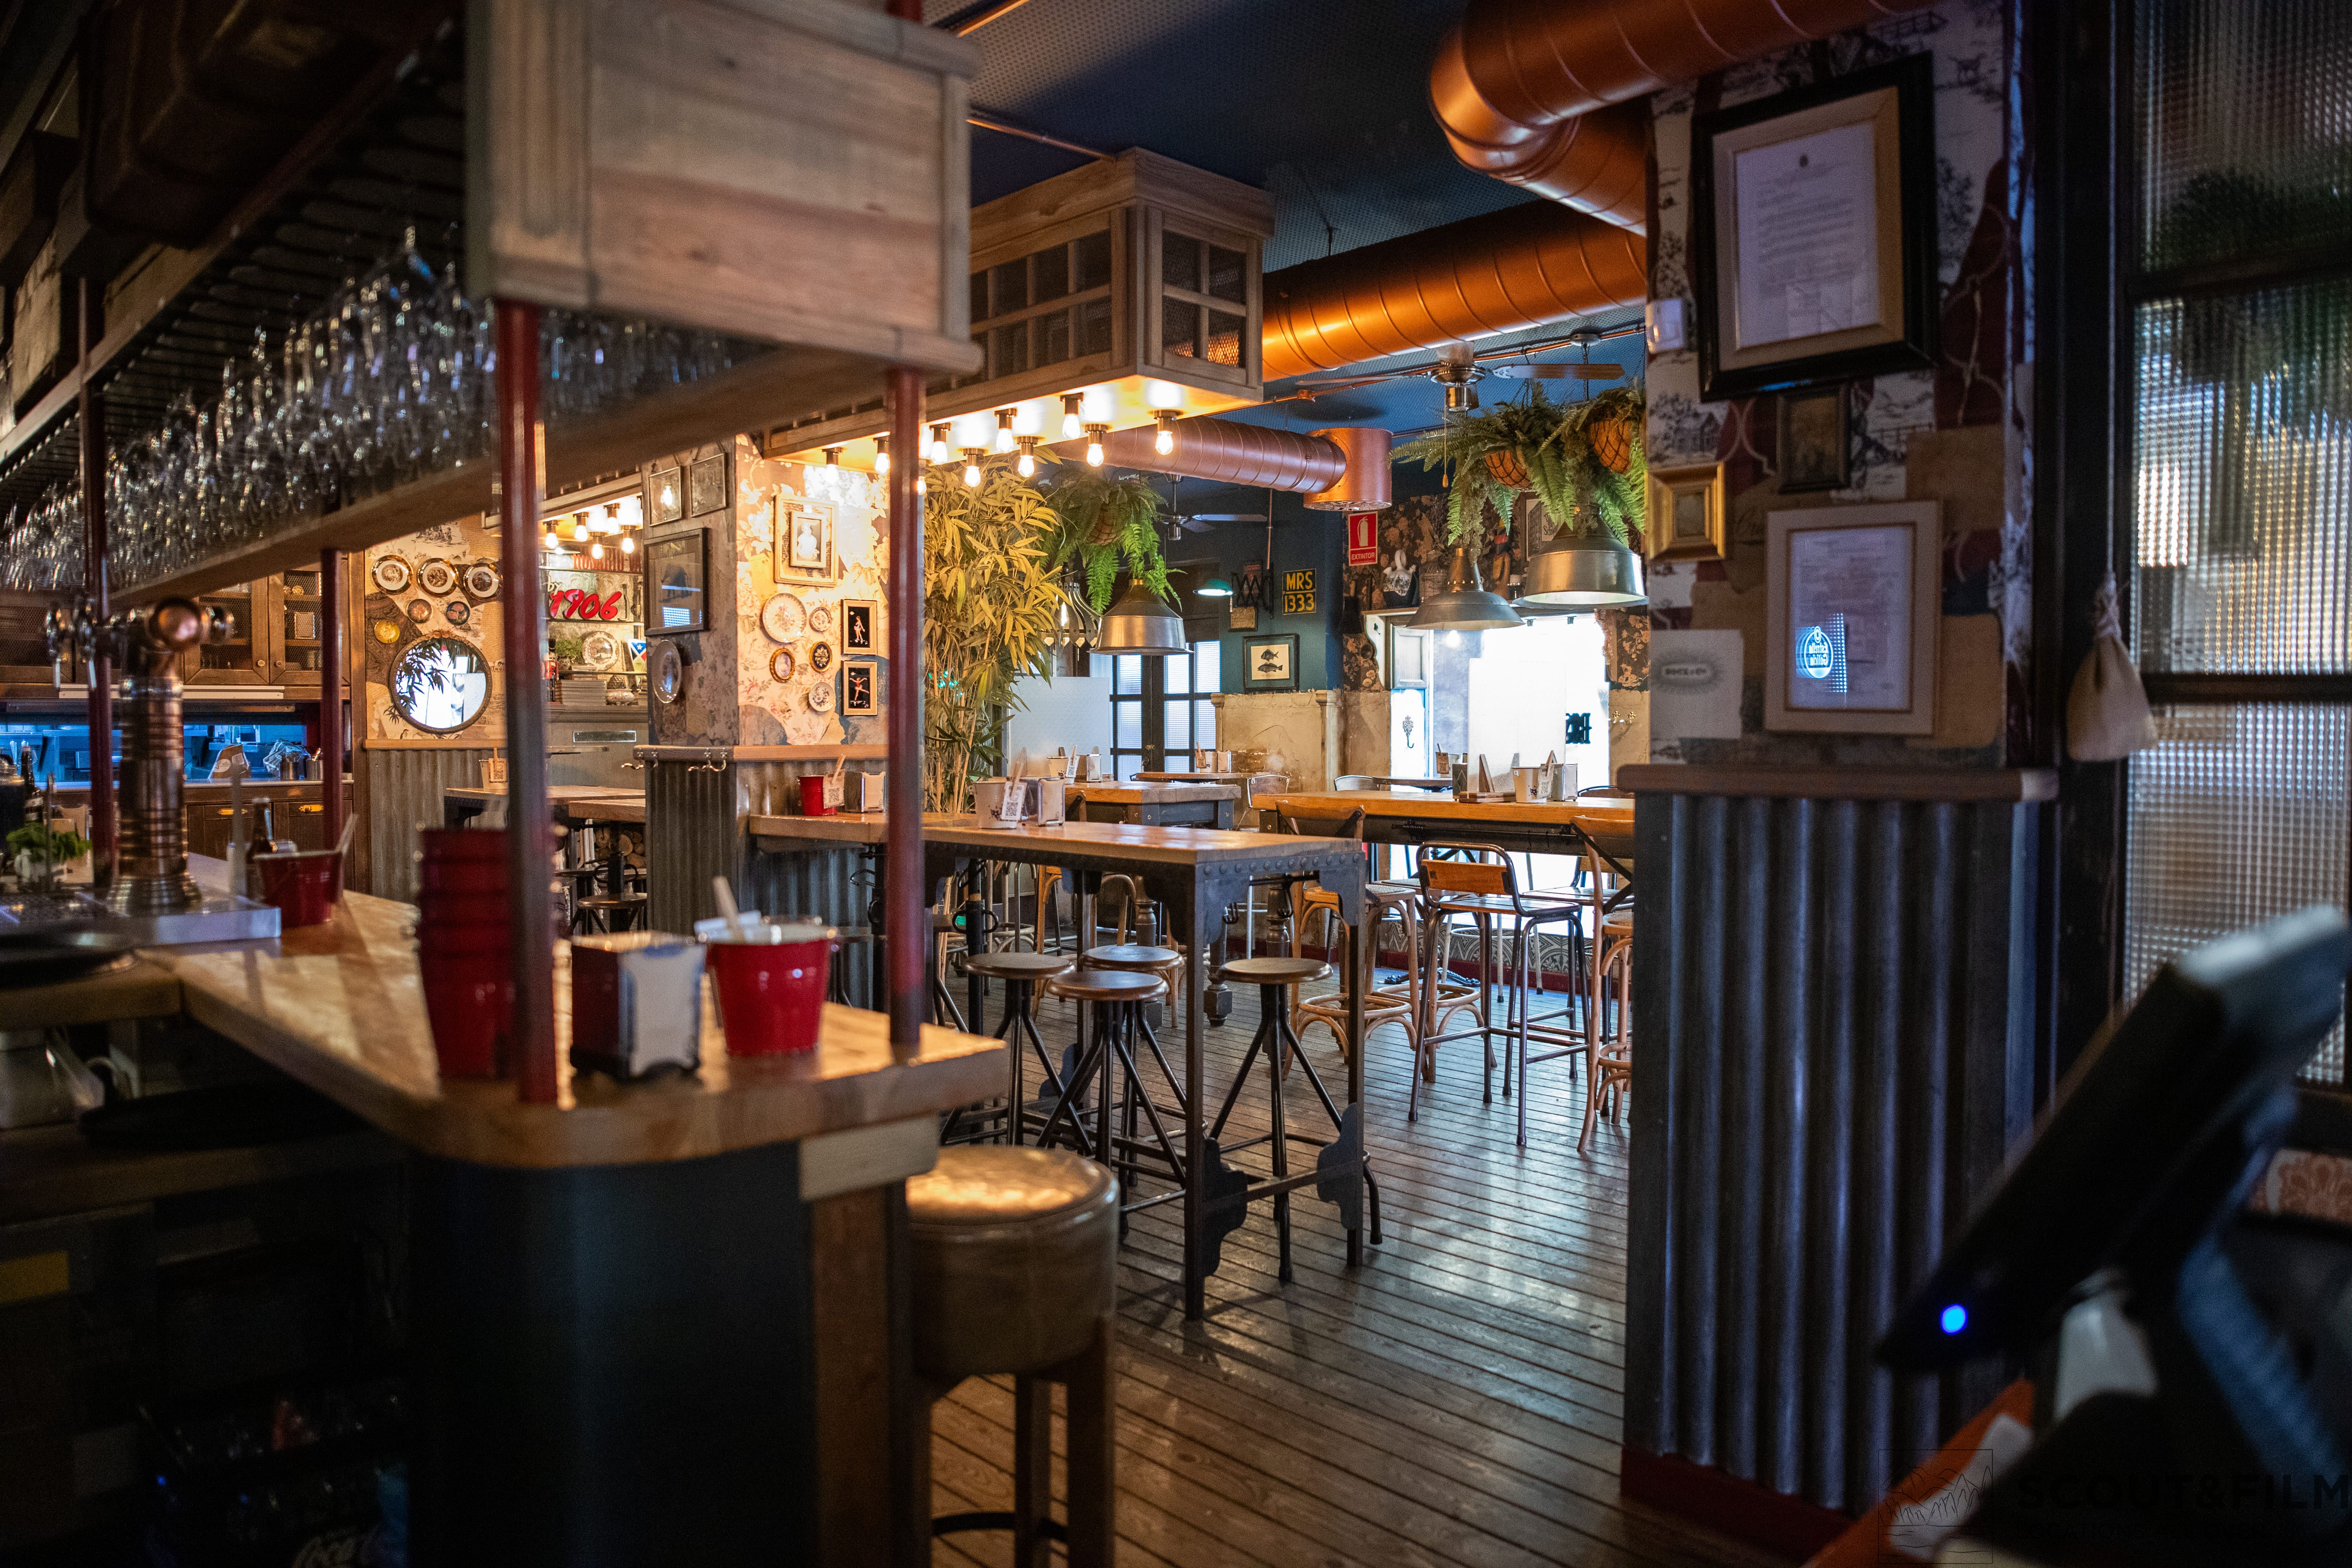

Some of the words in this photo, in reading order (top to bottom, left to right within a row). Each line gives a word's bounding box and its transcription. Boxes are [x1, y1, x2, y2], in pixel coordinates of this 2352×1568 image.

[547, 575, 563, 595] by
[1287, 571, 1313, 591] MRS
[549, 589, 622, 620] 1906
[1285, 593, 1314, 612] 1333
